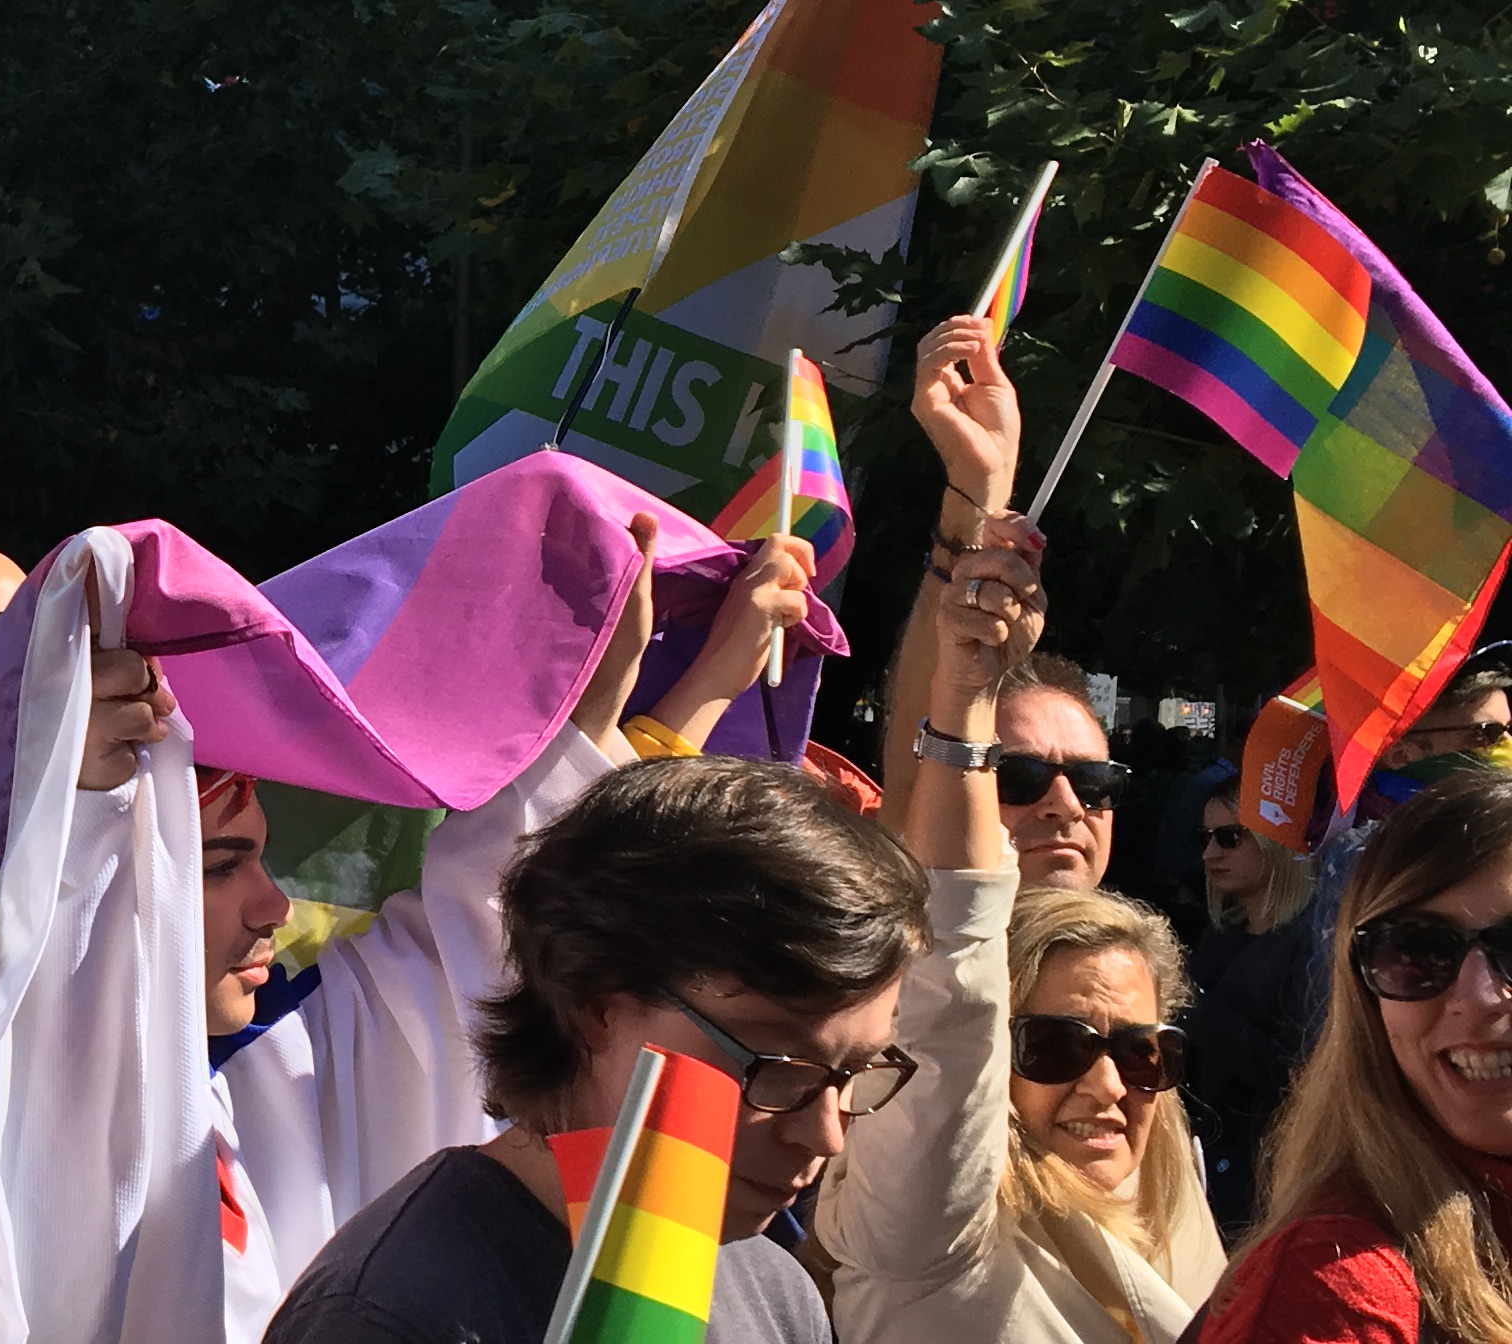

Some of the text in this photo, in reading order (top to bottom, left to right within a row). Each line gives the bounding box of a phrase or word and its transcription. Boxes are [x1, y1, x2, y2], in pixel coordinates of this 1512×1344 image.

[551, 314, 723, 447] THIS
[1261, 763, 1276, 795] CIVIL
[1273, 748, 1291, 800] RIGHTS
[1285, 723, 1323, 806] DEFENDERS
